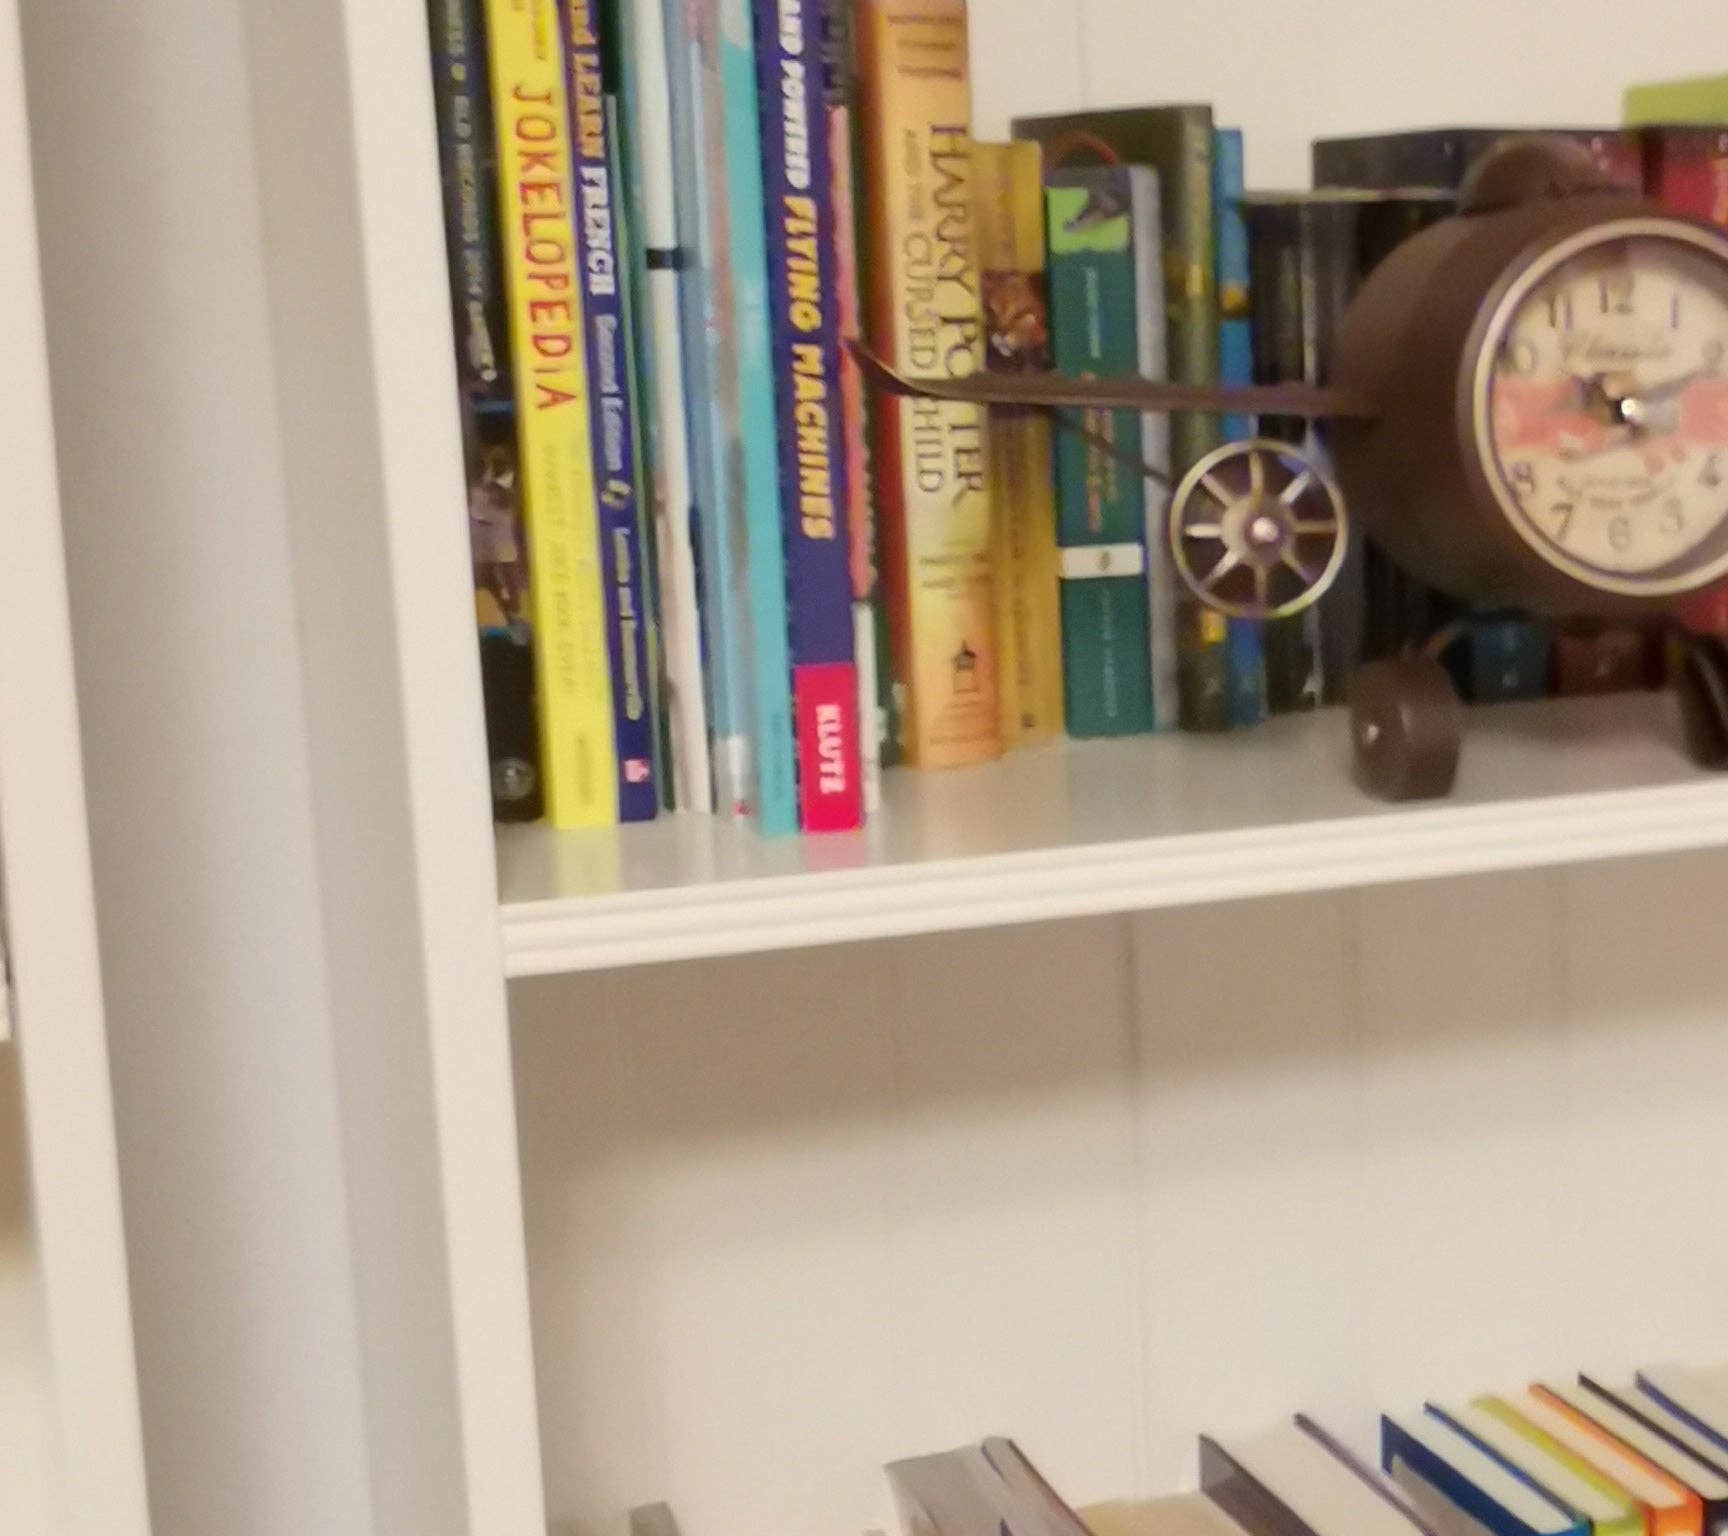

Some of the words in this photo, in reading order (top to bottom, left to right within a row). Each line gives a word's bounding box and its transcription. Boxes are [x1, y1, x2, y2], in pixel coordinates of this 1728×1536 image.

[572, 52, 606, 161] LEARN
[780, 59, 812, 192] POWERED
[511, 84, 579, 414] JOKELOPEDIA
[579, 166, 615, 295] FRENCH
[782, 196, 823, 333] FLYING
[929, 121, 979, 306] HARRY
[907, 228, 944, 371] CURSED
[1548, 290, 1574, 332] 11
[1597, 272, 1636, 315] 12
[1668, 289, 1681, 330] 1
[600, 396, 626, 473] Edition
[792, 343, 837, 541] MACHINES
[912, 397, 945, 495] HILD
[941, 314, 986, 508] POTER
[1551, 501, 1575, 542] 7
[814, 702, 848, 796] KLUTZ
